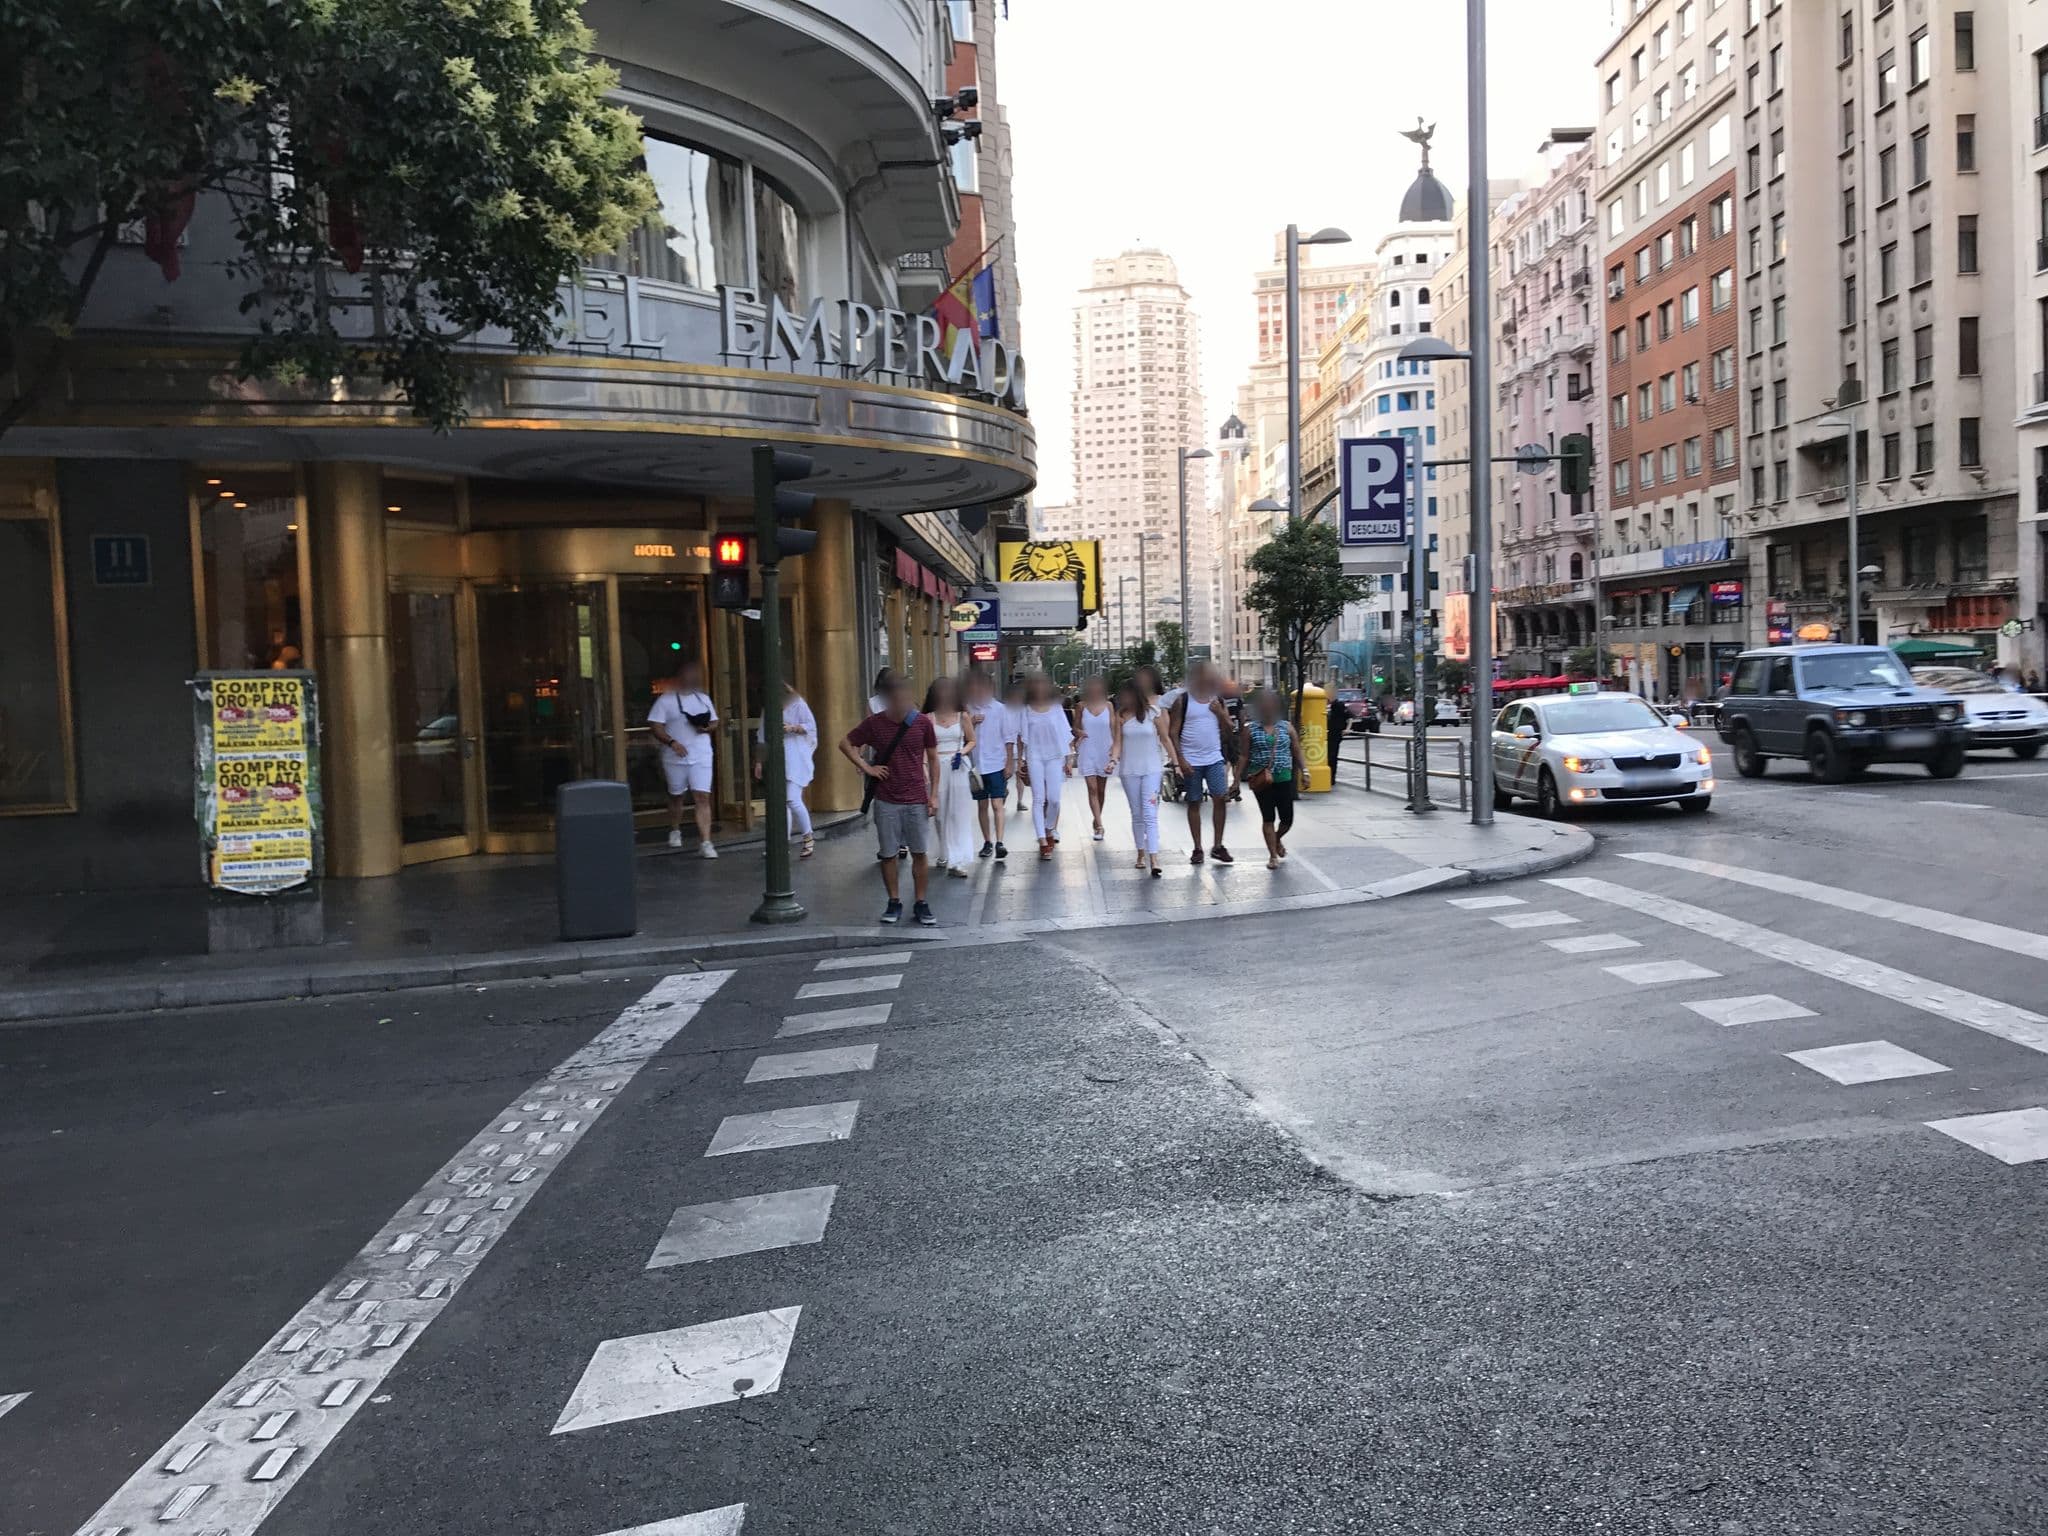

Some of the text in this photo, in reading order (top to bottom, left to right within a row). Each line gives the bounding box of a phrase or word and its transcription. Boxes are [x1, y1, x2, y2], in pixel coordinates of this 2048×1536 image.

[313, 262, 668, 346] HOEL
[1350, 444, 1399, 510] P
[1351, 523, 1398, 535] DESCALZAS
[634, 545, 676, 557] HOTEL
[215, 682, 298, 694] COMPRO
[220, 760, 301, 774] COMPRO
